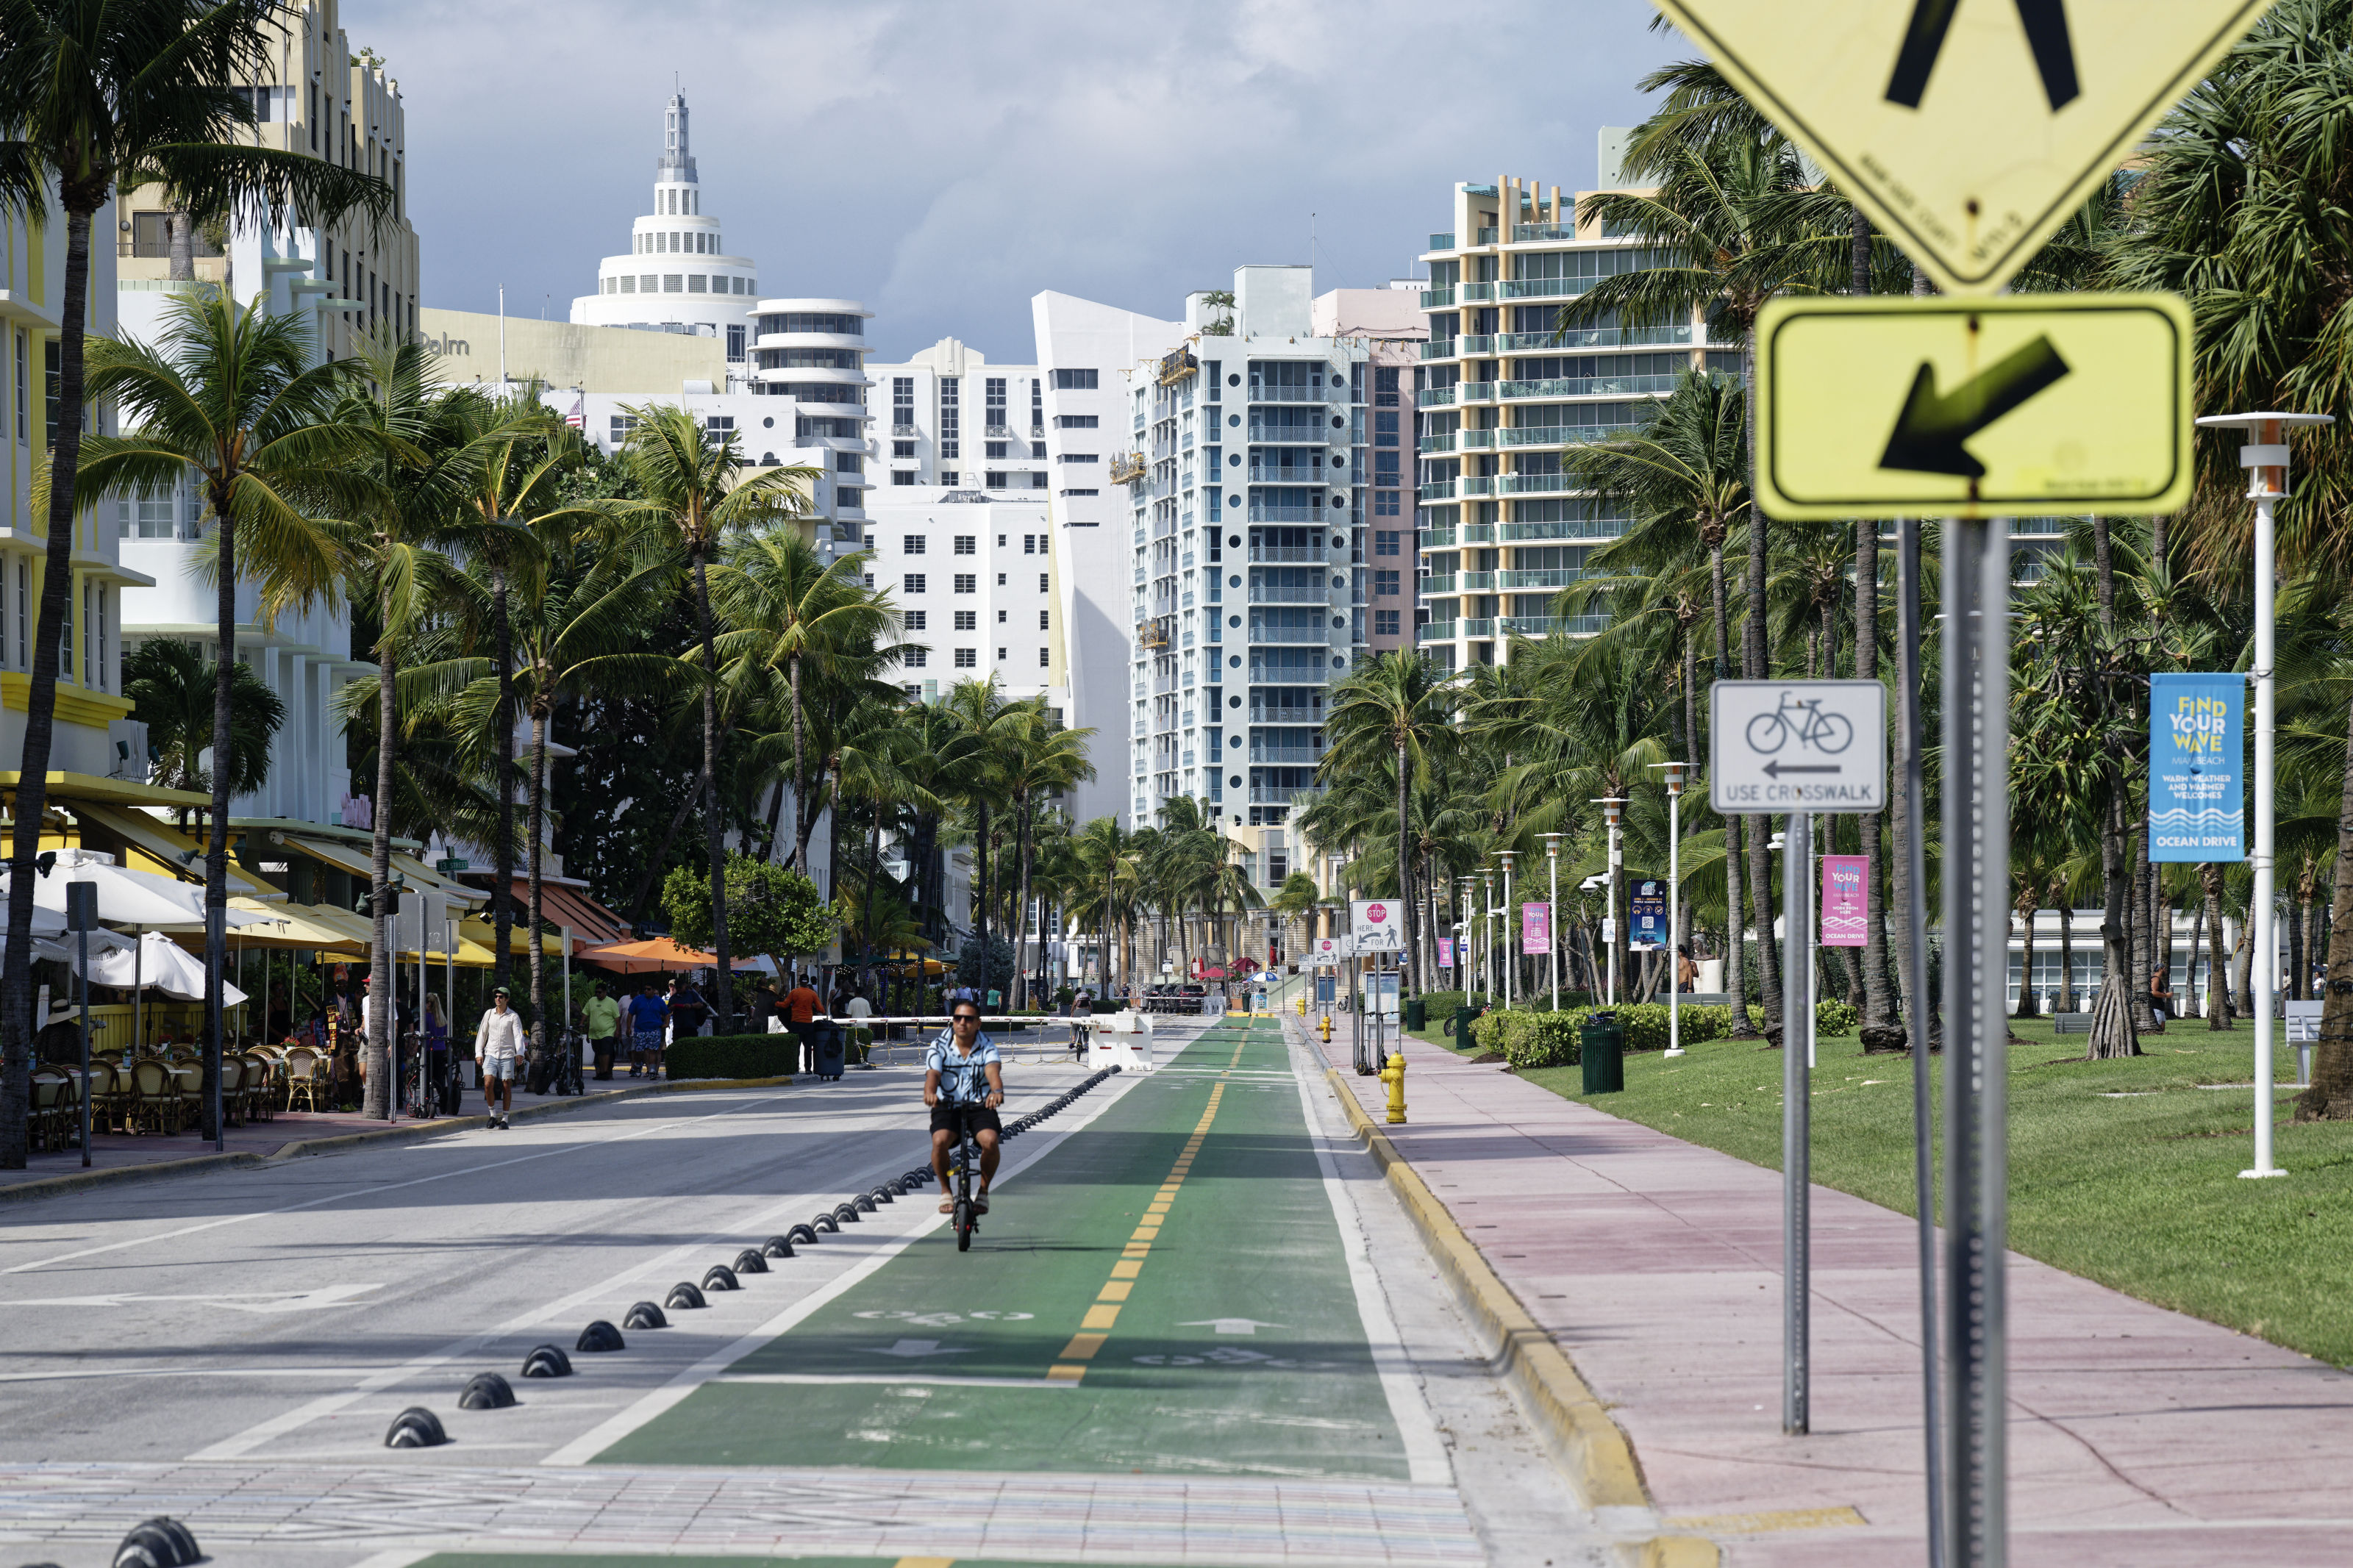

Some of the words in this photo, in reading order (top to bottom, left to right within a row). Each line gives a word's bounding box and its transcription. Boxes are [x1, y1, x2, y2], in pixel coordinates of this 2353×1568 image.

[418, 331, 469, 356] Palm
[2179, 697, 2227, 717] FIND
[2169, 714, 2226, 734] YOUR
[2173, 731, 2222, 753] WAVE
[1727, 784, 1760, 801] USE
[1766, 784, 1872, 801] CROSSWALK
[2156, 837, 2199, 847] OCEAN
[2202, 837, 2237, 847] DRIVE
[1836, 864, 1860, 874] FIND
[1832, 873, 1860, 882] YOUR
[1834, 881, 1858, 892] WAVE
[1368, 909, 1386, 917] STOP
